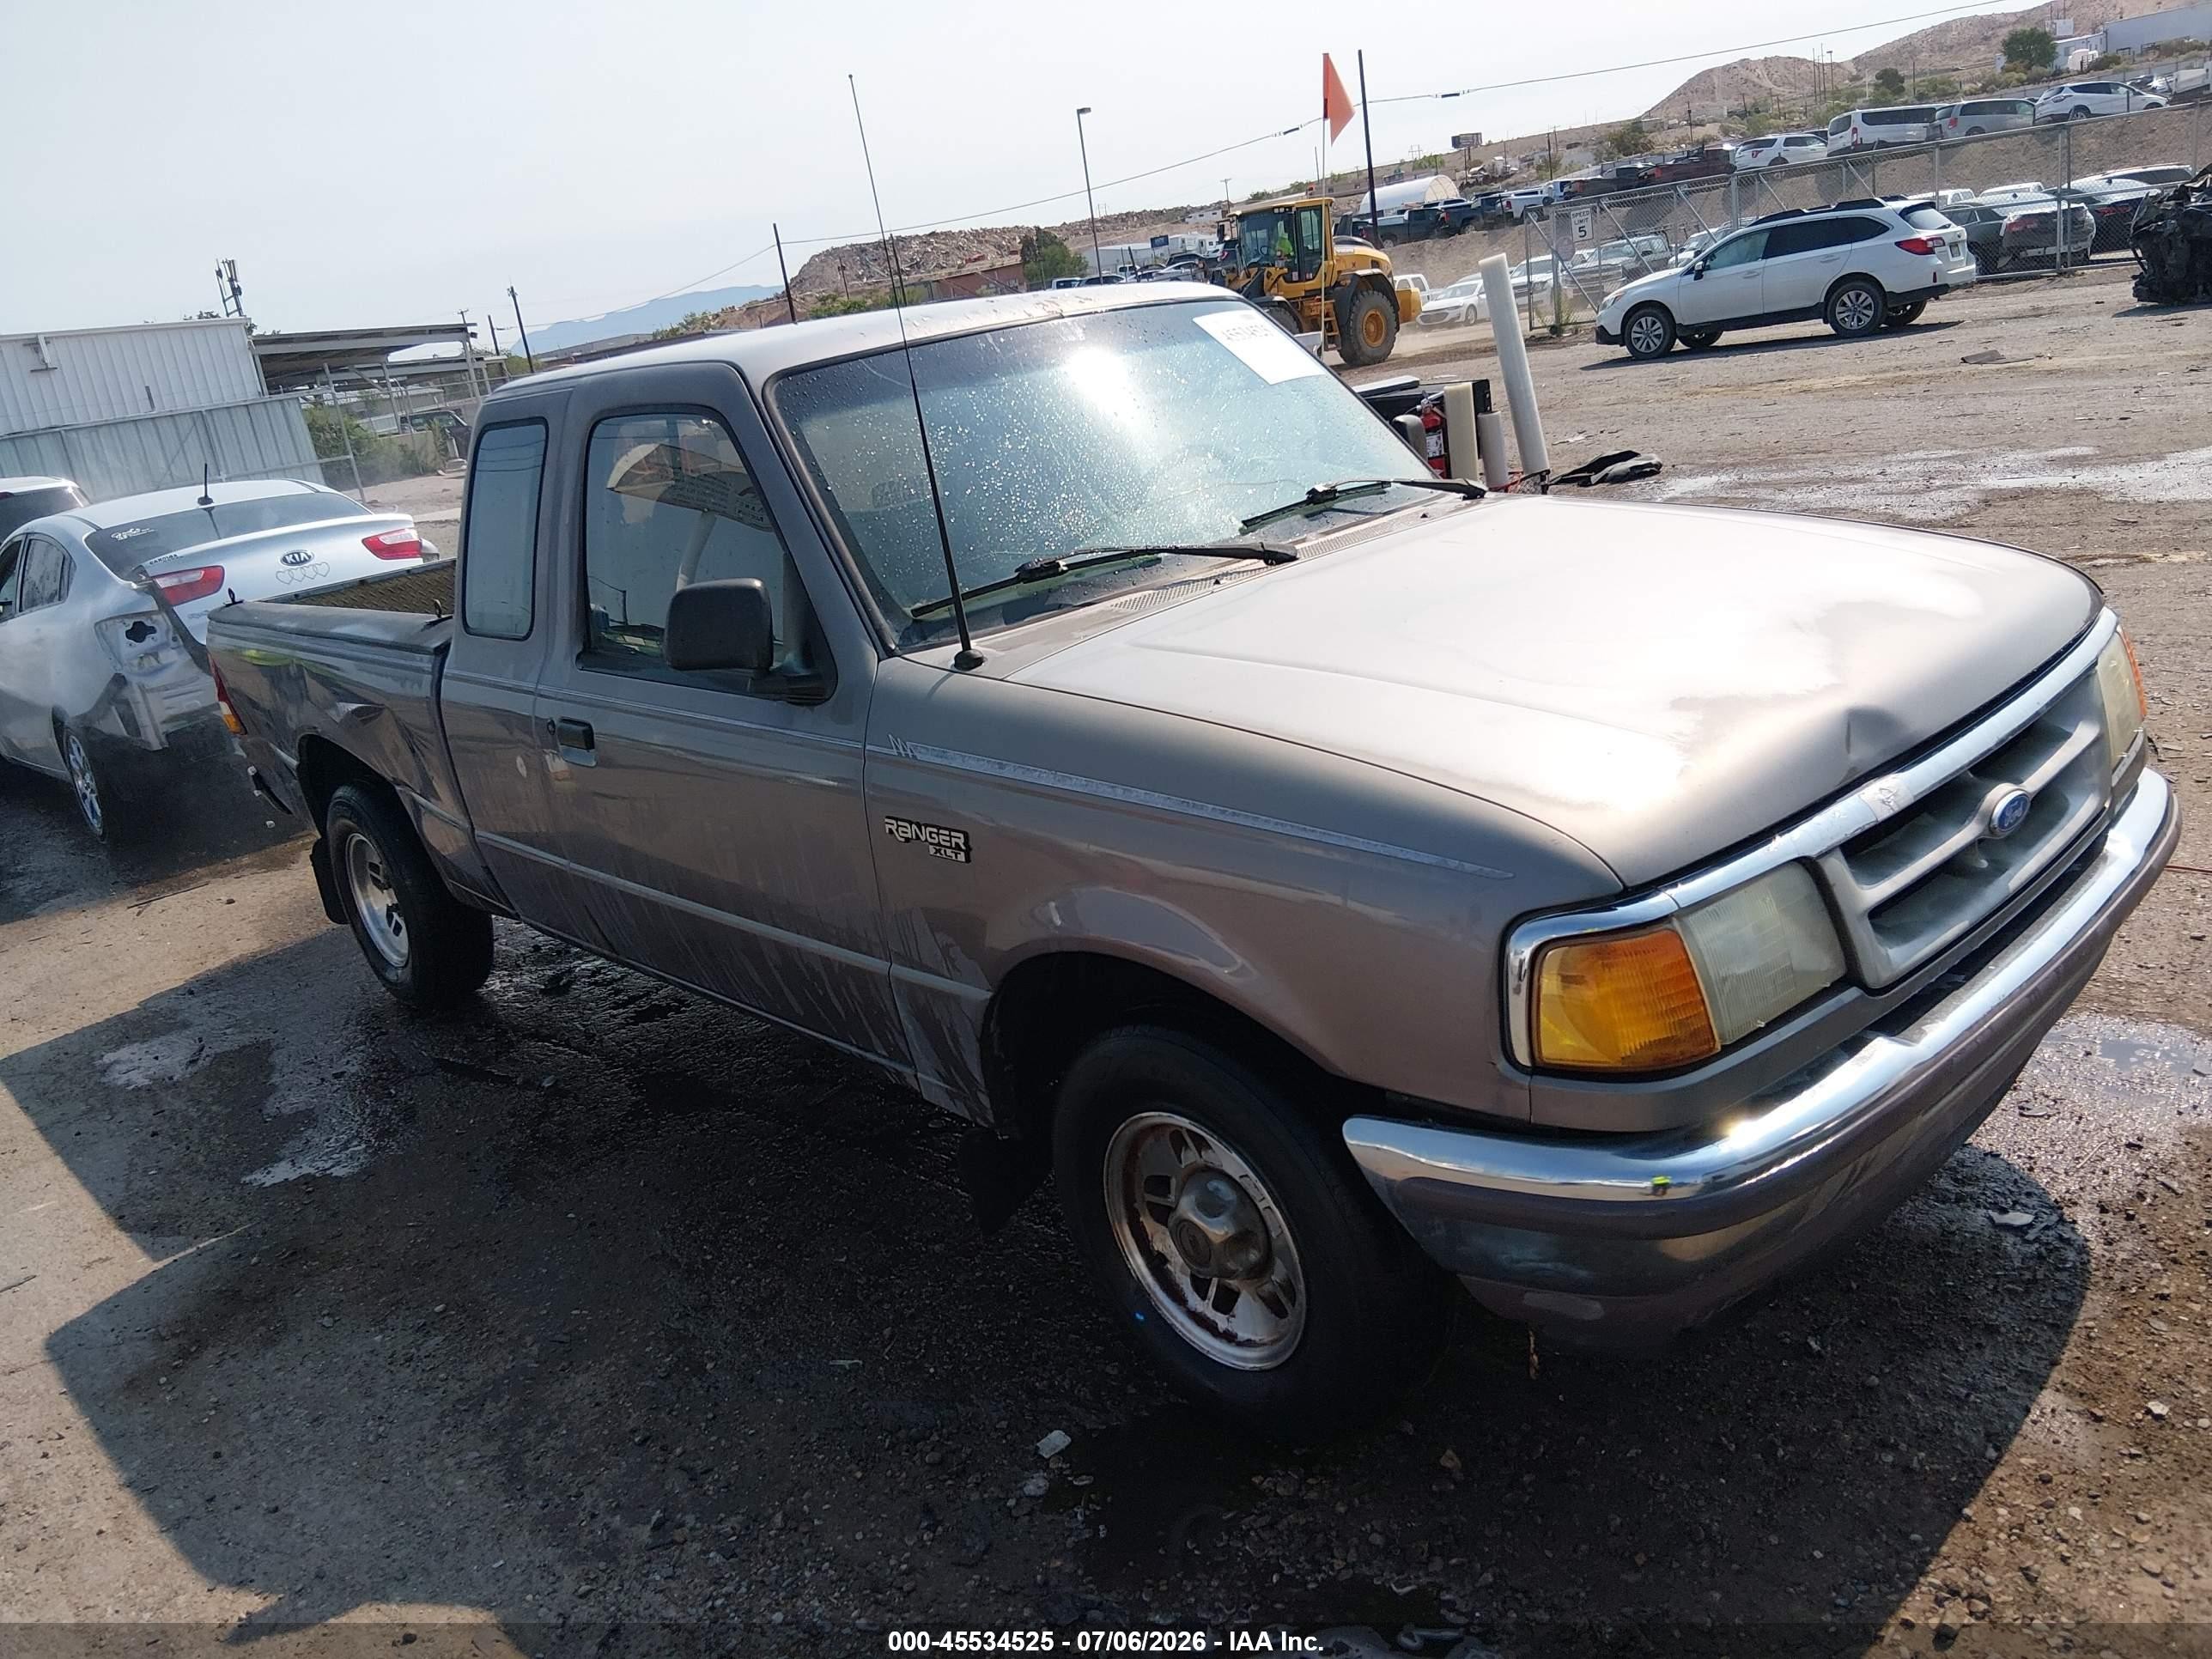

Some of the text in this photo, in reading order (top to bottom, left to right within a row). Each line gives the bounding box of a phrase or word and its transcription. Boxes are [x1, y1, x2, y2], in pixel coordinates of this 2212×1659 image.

[1578, 225, 1587, 238] 5
[284, 552, 310, 564] KIA
[933, 846, 963, 860] XLT
